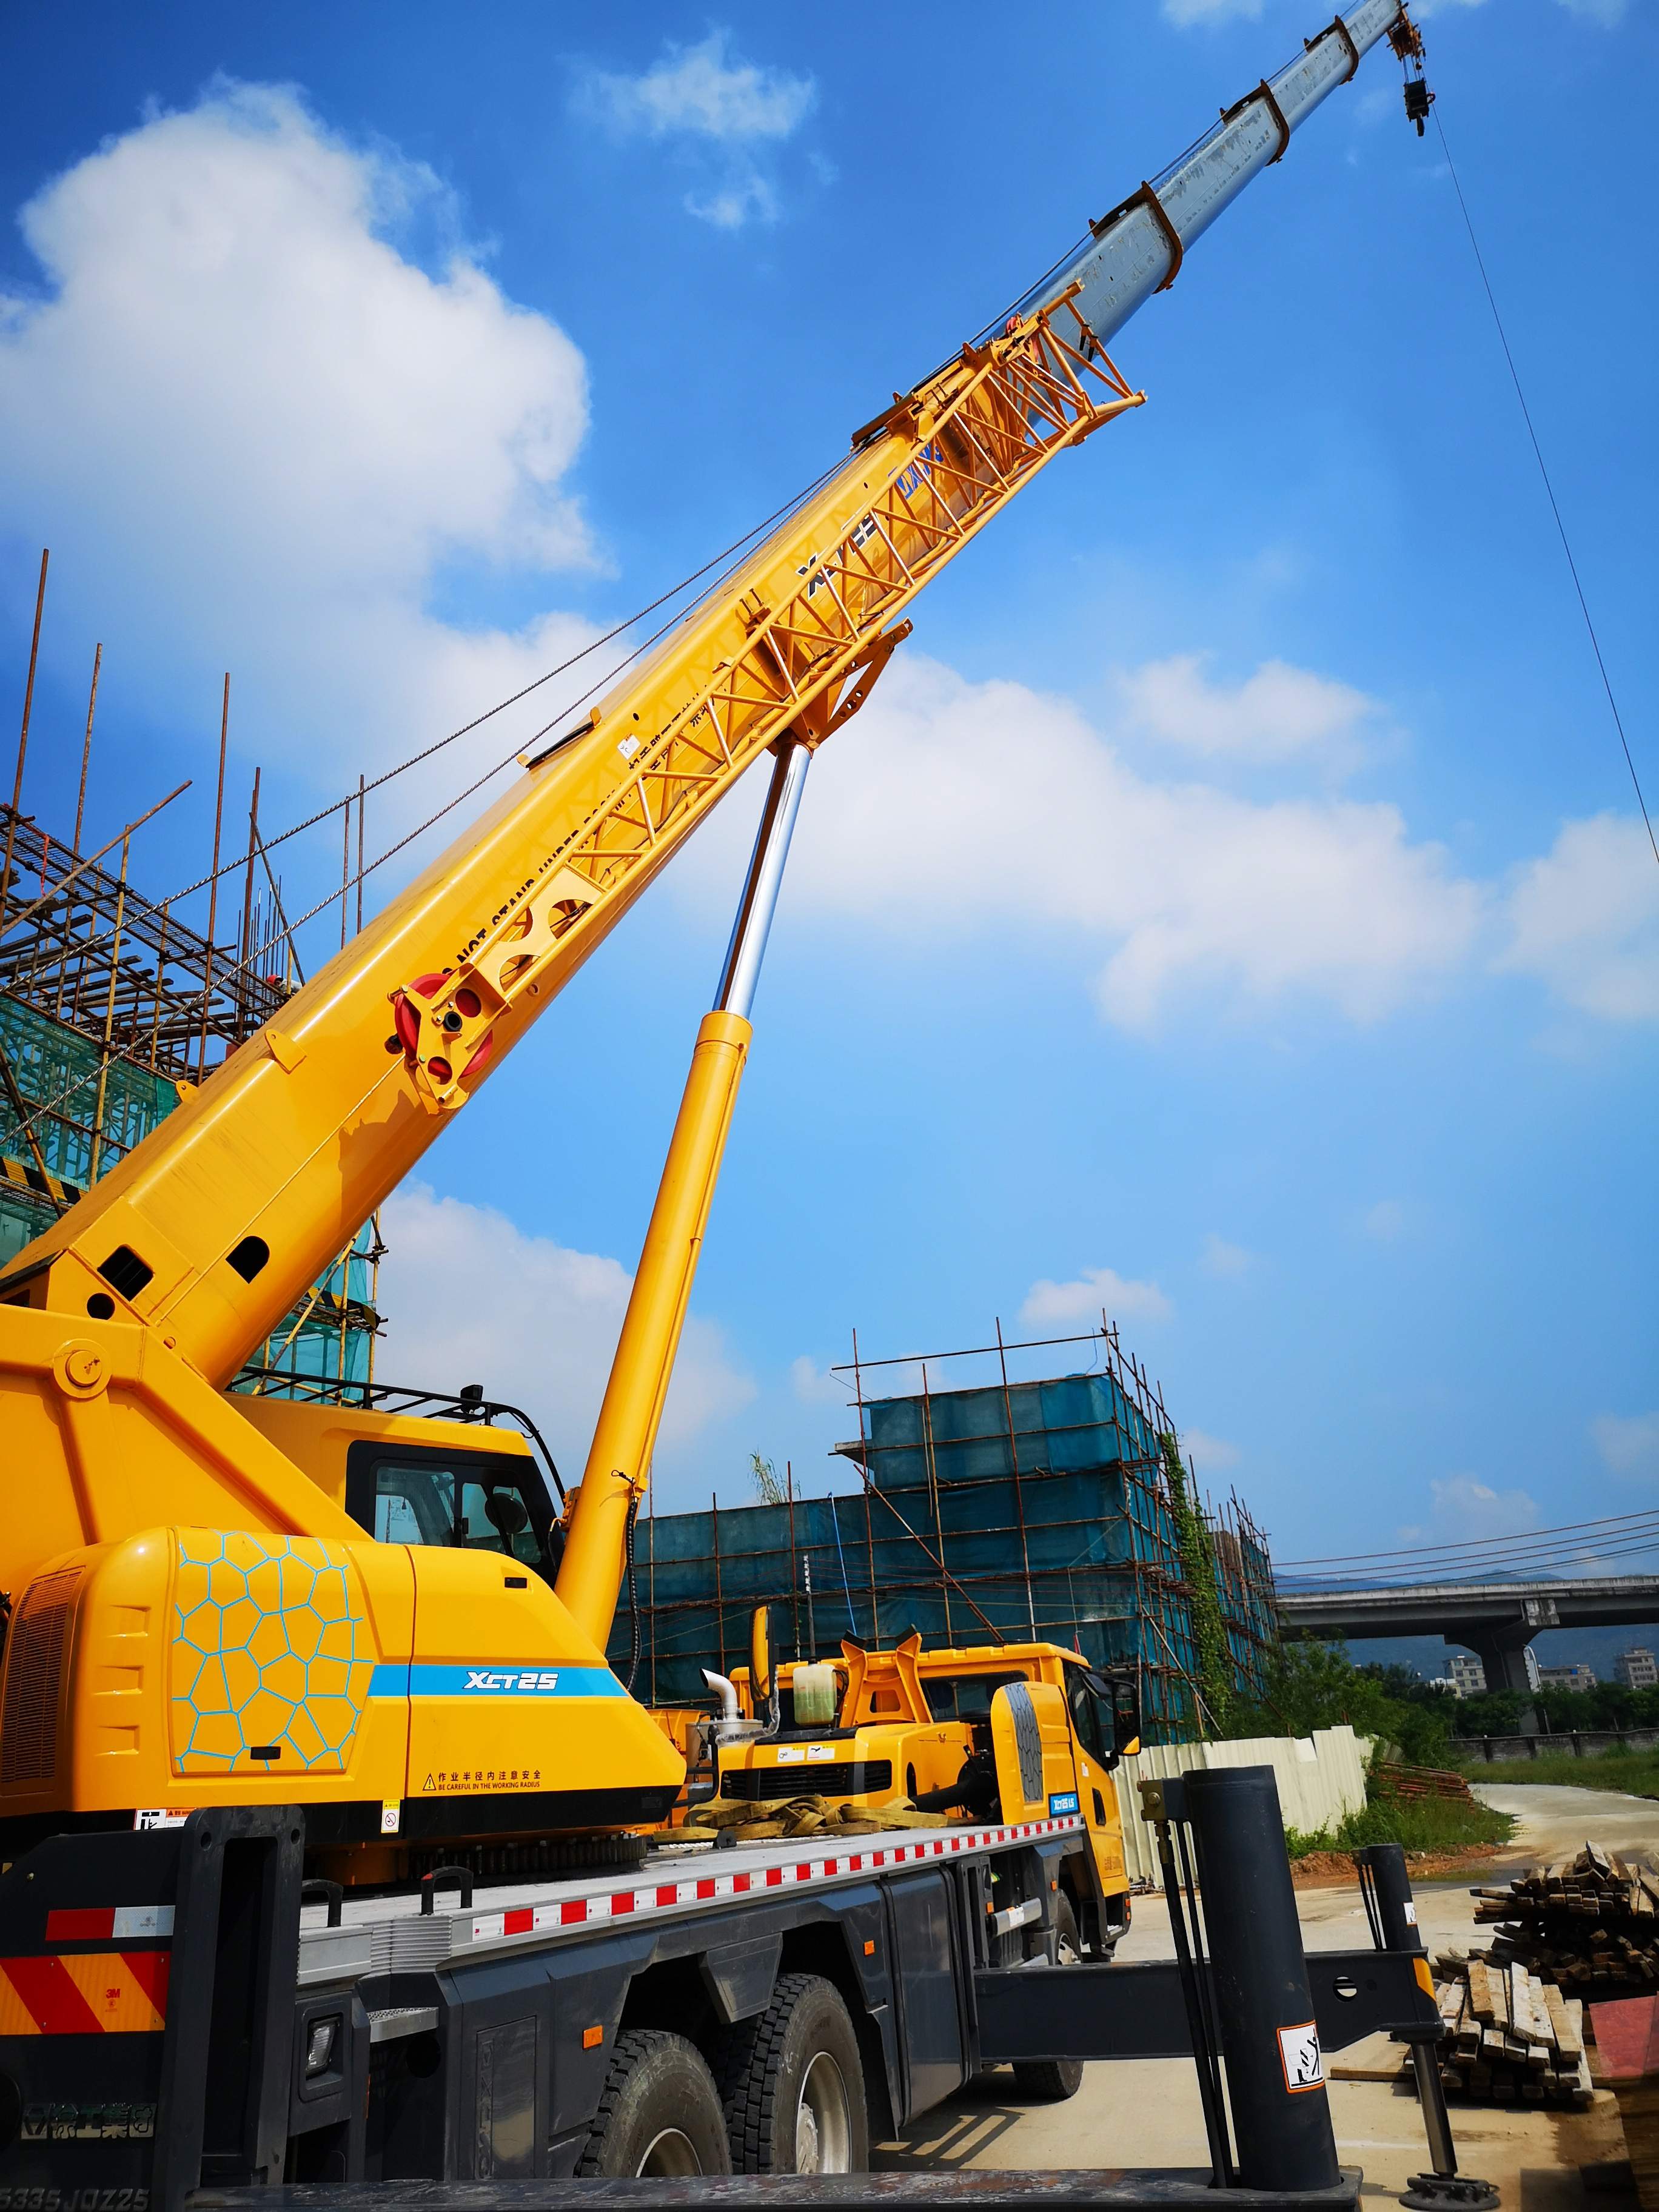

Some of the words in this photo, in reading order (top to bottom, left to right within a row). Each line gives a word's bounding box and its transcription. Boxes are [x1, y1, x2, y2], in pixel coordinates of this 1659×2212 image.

[462, 1671, 559, 1690] XCT25
[438, 1769, 540, 1782] 作业半径内注意安全
[106, 1988, 121, 1999] 3M
